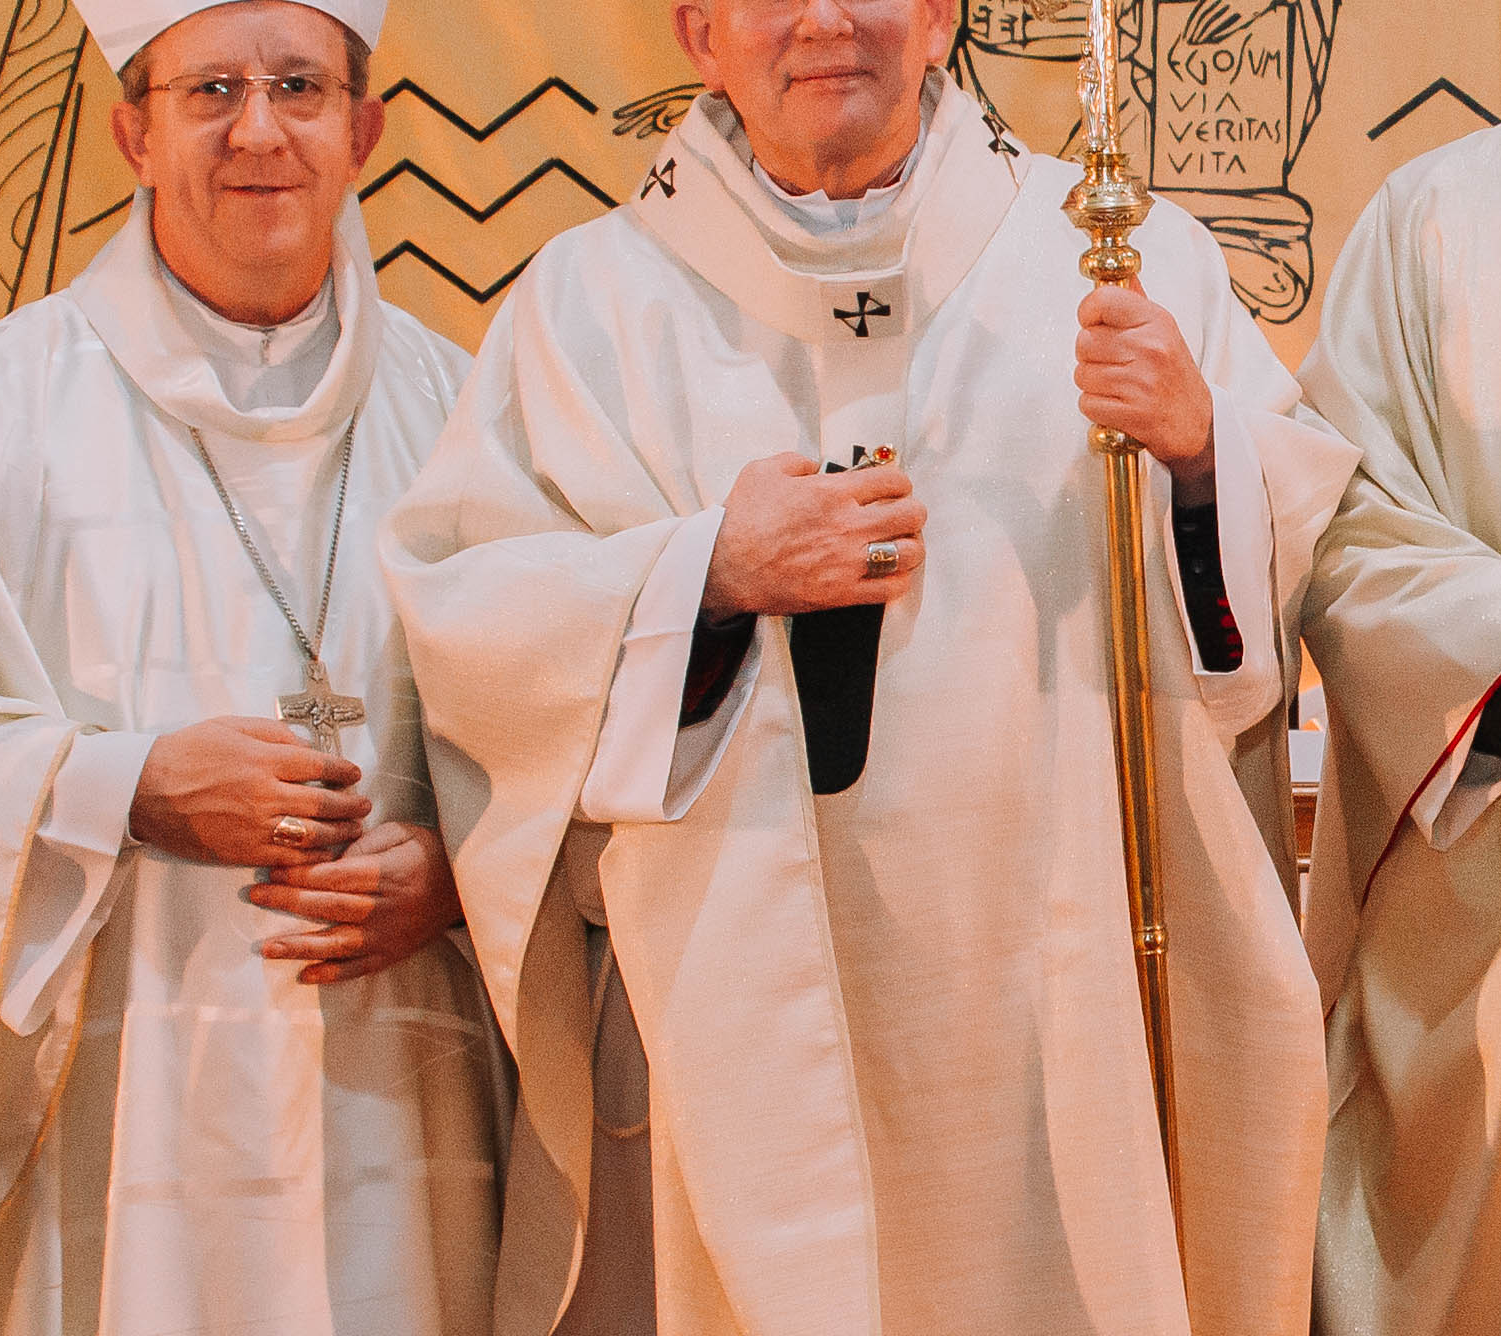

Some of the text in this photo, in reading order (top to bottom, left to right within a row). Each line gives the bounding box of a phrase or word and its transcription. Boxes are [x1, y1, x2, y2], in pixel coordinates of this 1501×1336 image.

[1169, 90, 1242, 114] VIA
[1167, 116, 1282, 144] VERITAS
[1167, 150, 1247, 175] VITA
